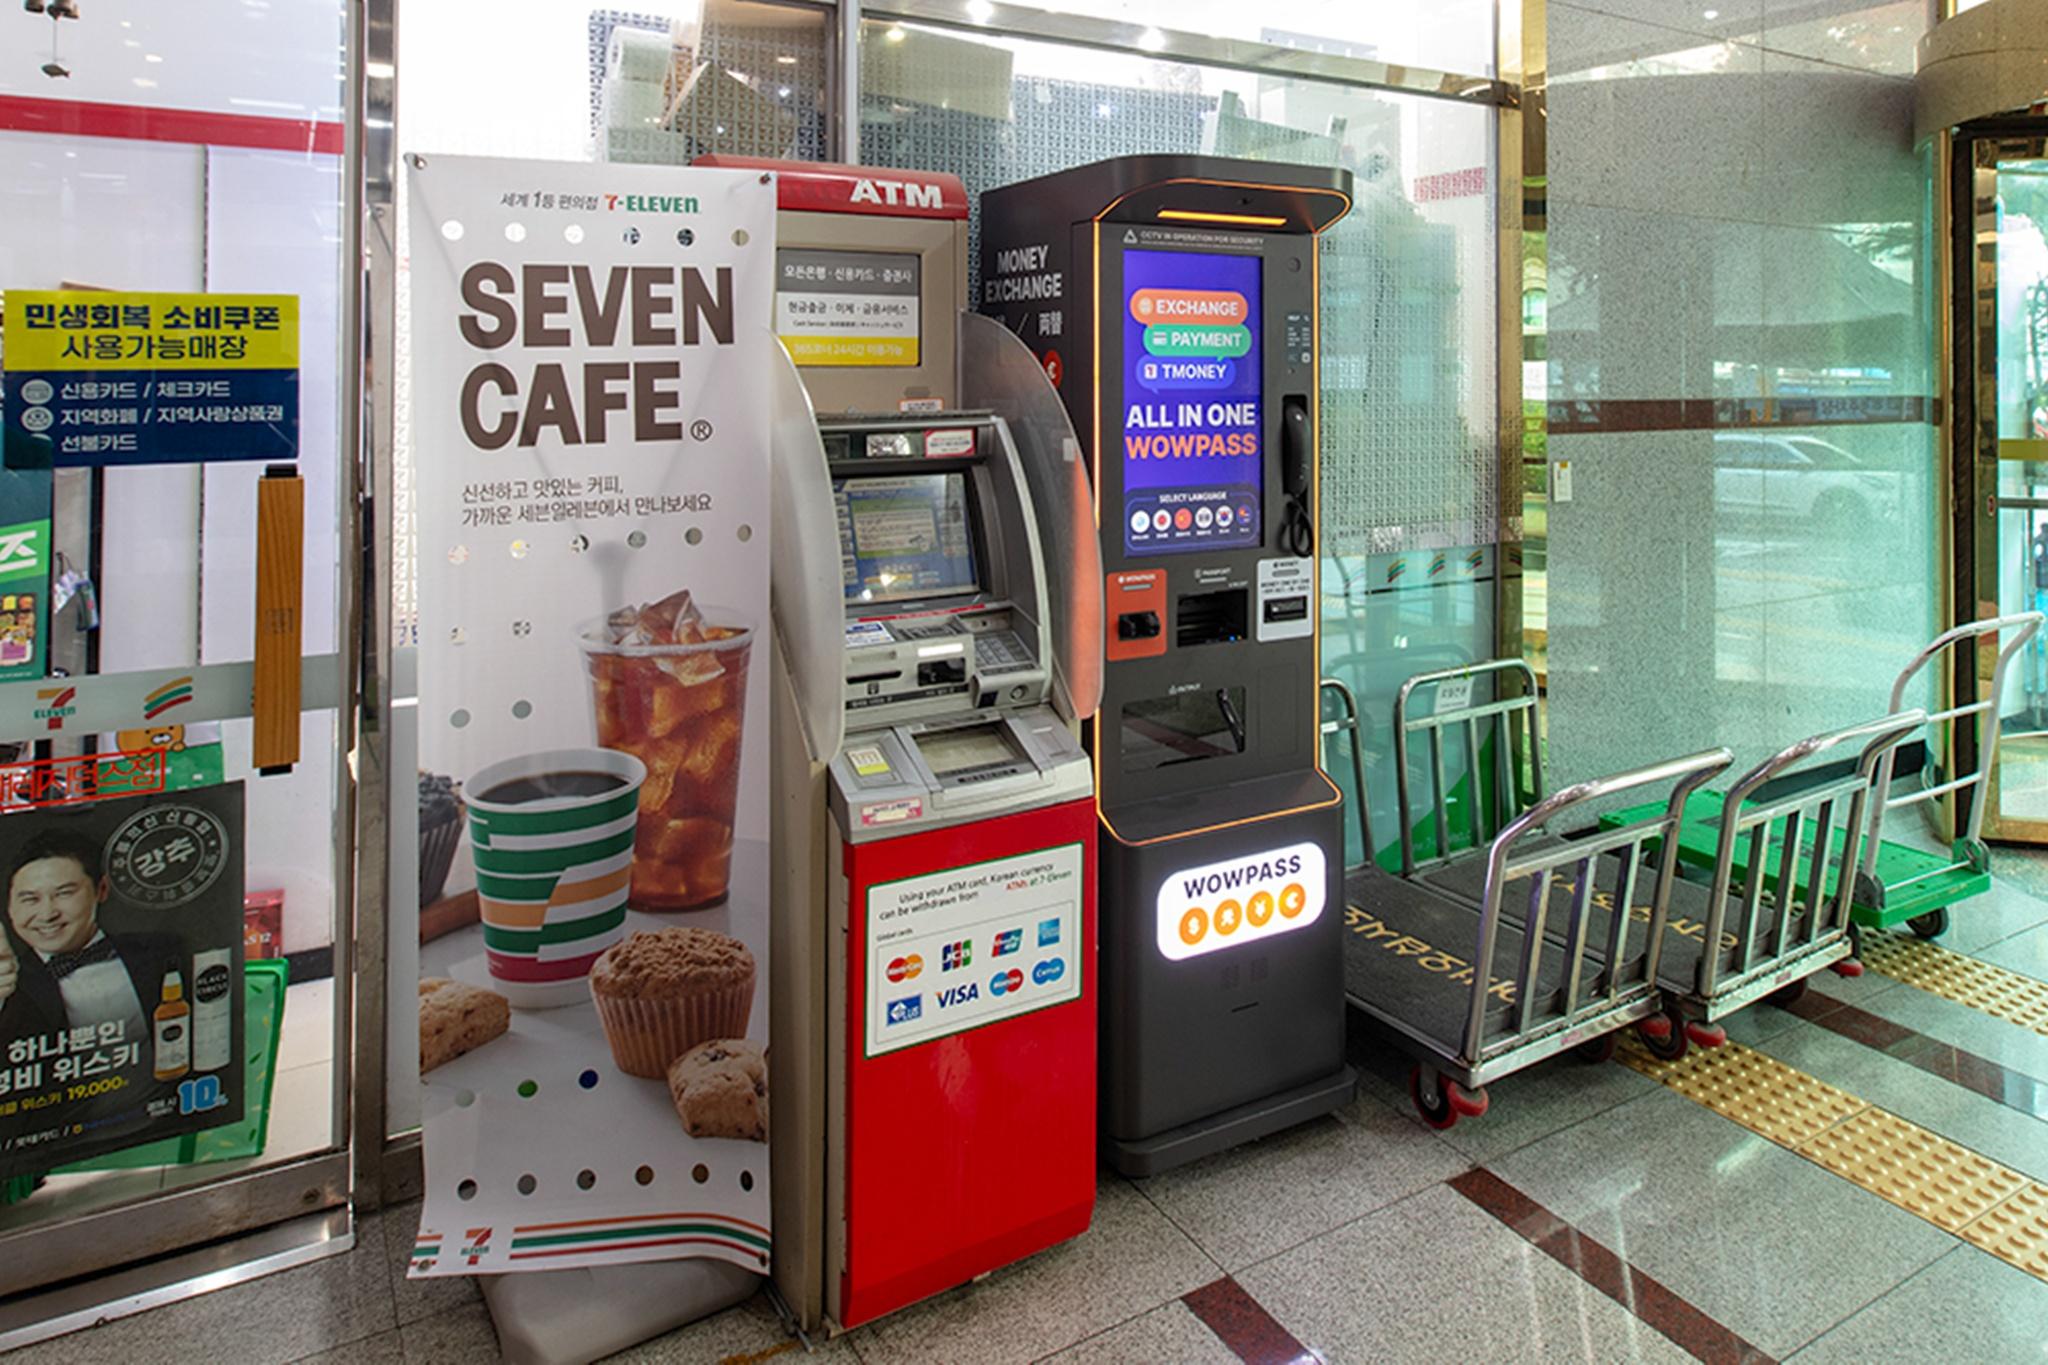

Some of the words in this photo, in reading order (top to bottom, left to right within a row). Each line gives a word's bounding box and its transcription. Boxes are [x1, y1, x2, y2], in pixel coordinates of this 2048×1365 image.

[501, 192, 528, 208] 세계
[534, 190, 555, 209] 1등
[559, 194, 599, 210] 편의점
[604, 193, 700, 214] 7-ELEVEN
[850, 178, 943, 209] ATM
[1140, 231, 1162, 239] CCTV
[1173, 232, 1213, 241] OPERATION
[997, 245, 1048, 274] MONEY
[985, 273, 1062, 303] EXCHANGE
[25, 303, 150, 330] 민생회복
[163, 305, 281, 331] 소비쿠폰
[459, 262, 735, 350] SEVEN
[1156, 299, 1239, 317] EXCHANGE
[61, 335, 249, 360] 사용가능매장
[1171, 332, 1242, 348] PAYMENT
[1162, 364, 1226, 379] TMONEY
[60, 382, 137, 400] 신용카드
[157, 380, 231, 398] 체크카드
[60, 406, 138, 426] 지역화폐
[157, 405, 284, 424] 지역사랑상품권
[1126, 405, 1173, 429] ALL
[1178, 404, 1202, 428] IN
[1207, 403, 1256, 427] ONE
[61, 434, 138, 453] 선불카드
[1125, 433, 1257, 460] WOWPASS
[462, 480, 528, 504] 신선하고
[532, 477, 582, 499] 맛있는
[587, 475, 624, 494] 커피,
[1159, 493, 1187, 504] SELECT
[1188, 491, 1227, 502] LANGUAGE
[462, 505, 512, 527] 가까운
[518, 498, 631, 523] 세븐일레븐에서
[635, 493, 712, 516] 만나보세요
[134, 836, 196, 878] 강추
[899, 891, 924, 903] Using
[926, 888, 946, 899] your
[947, 880, 966, 893] ATM
[990, 870, 1020, 884] Korean
[1020, 864, 1054, 879] currency
[1184, 855, 1301, 899] WOWPASS
[910, 897, 957, 914] withdrawn
[958, 891, 979, 902] from
[935, 983, 979, 1008] VISA
[8, 1020, 125, 1063] 하나뿐인
[53, 1042, 139, 1082] 위스키
